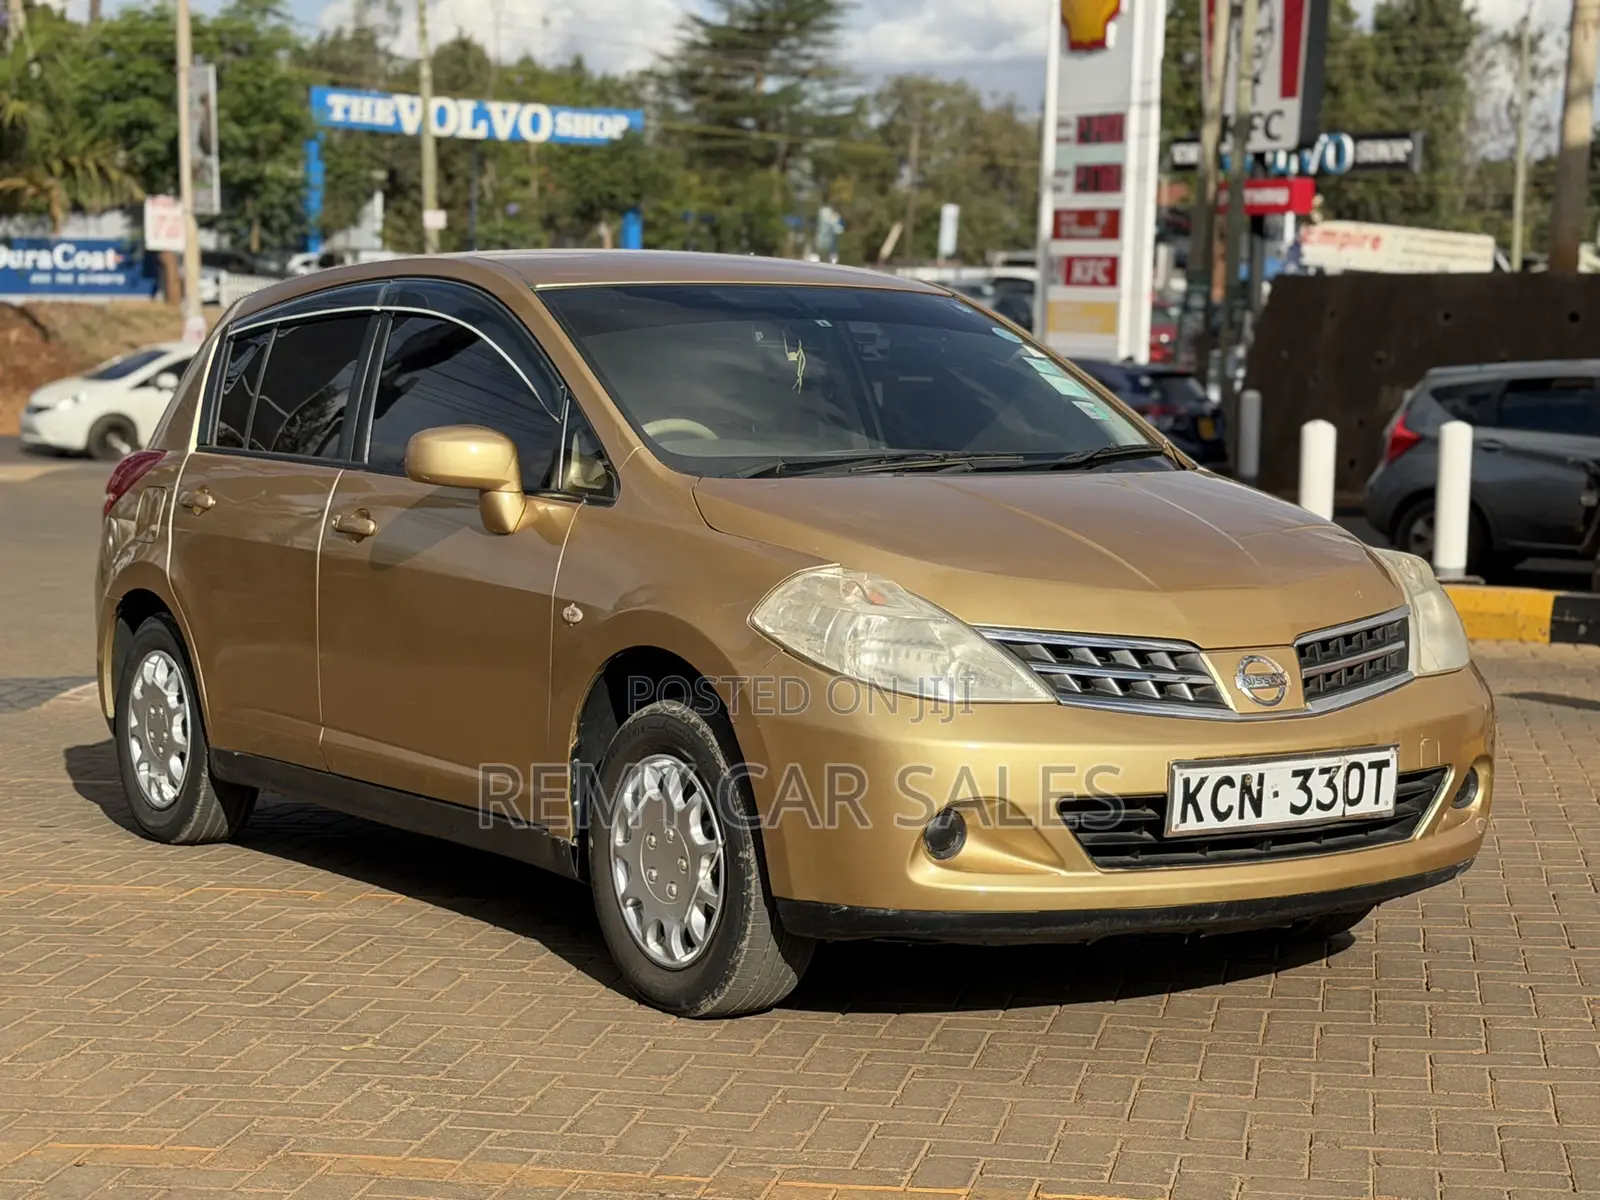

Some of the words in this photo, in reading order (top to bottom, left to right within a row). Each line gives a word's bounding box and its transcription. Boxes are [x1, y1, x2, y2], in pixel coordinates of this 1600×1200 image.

[326, 93, 394, 126] THE
[392, 93, 551, 143] VOLVO
[554, 111, 630, 139] SHOP
[1243, 674, 1287, 687] NISSAN
[1180, 771, 1265, 824] KCN
[1289, 759, 1390, 816] 330T
